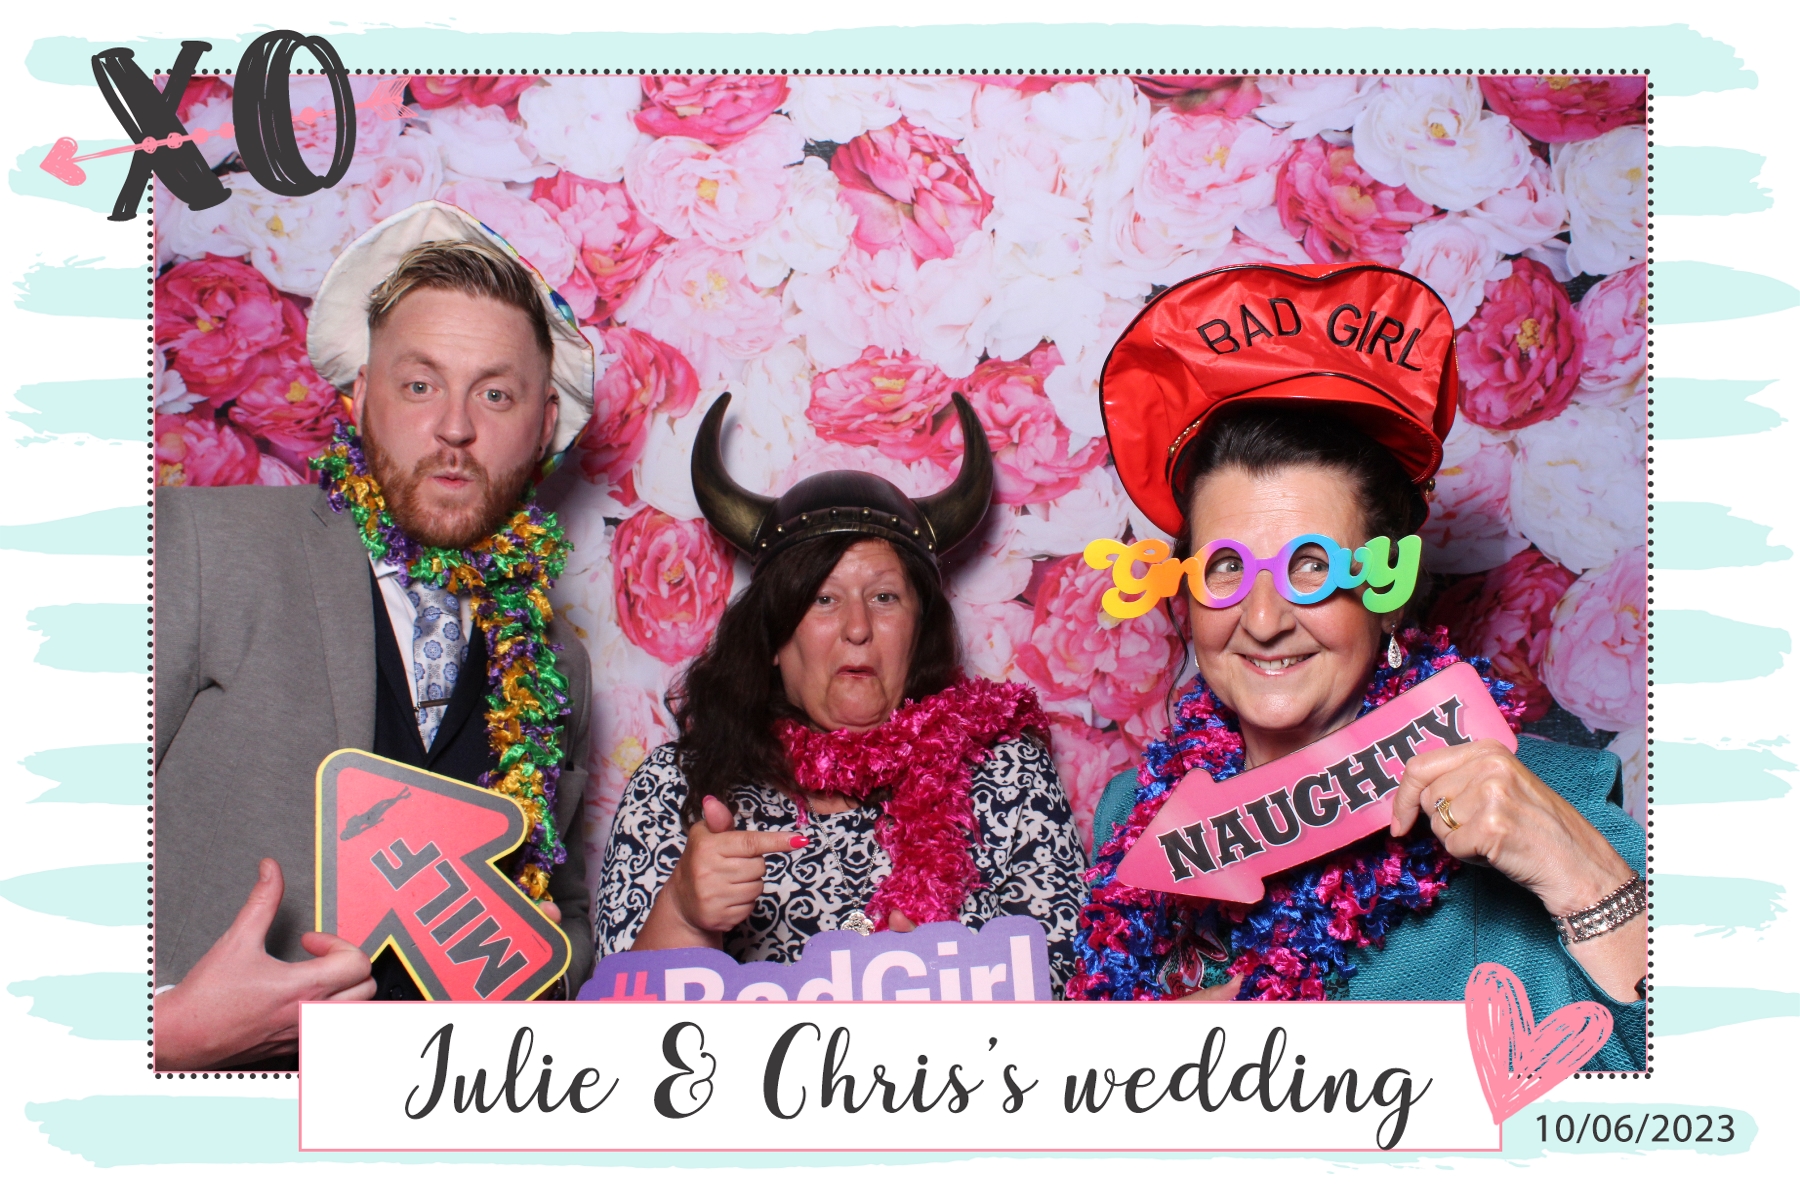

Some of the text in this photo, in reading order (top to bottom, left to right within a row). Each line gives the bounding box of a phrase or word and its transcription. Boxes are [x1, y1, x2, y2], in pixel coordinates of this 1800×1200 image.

[1196, 297, 1423, 372] BAD GIRL
[1157, 694, 1473, 883] NAUGHTY
[370, 837, 530, 1000] MILF
